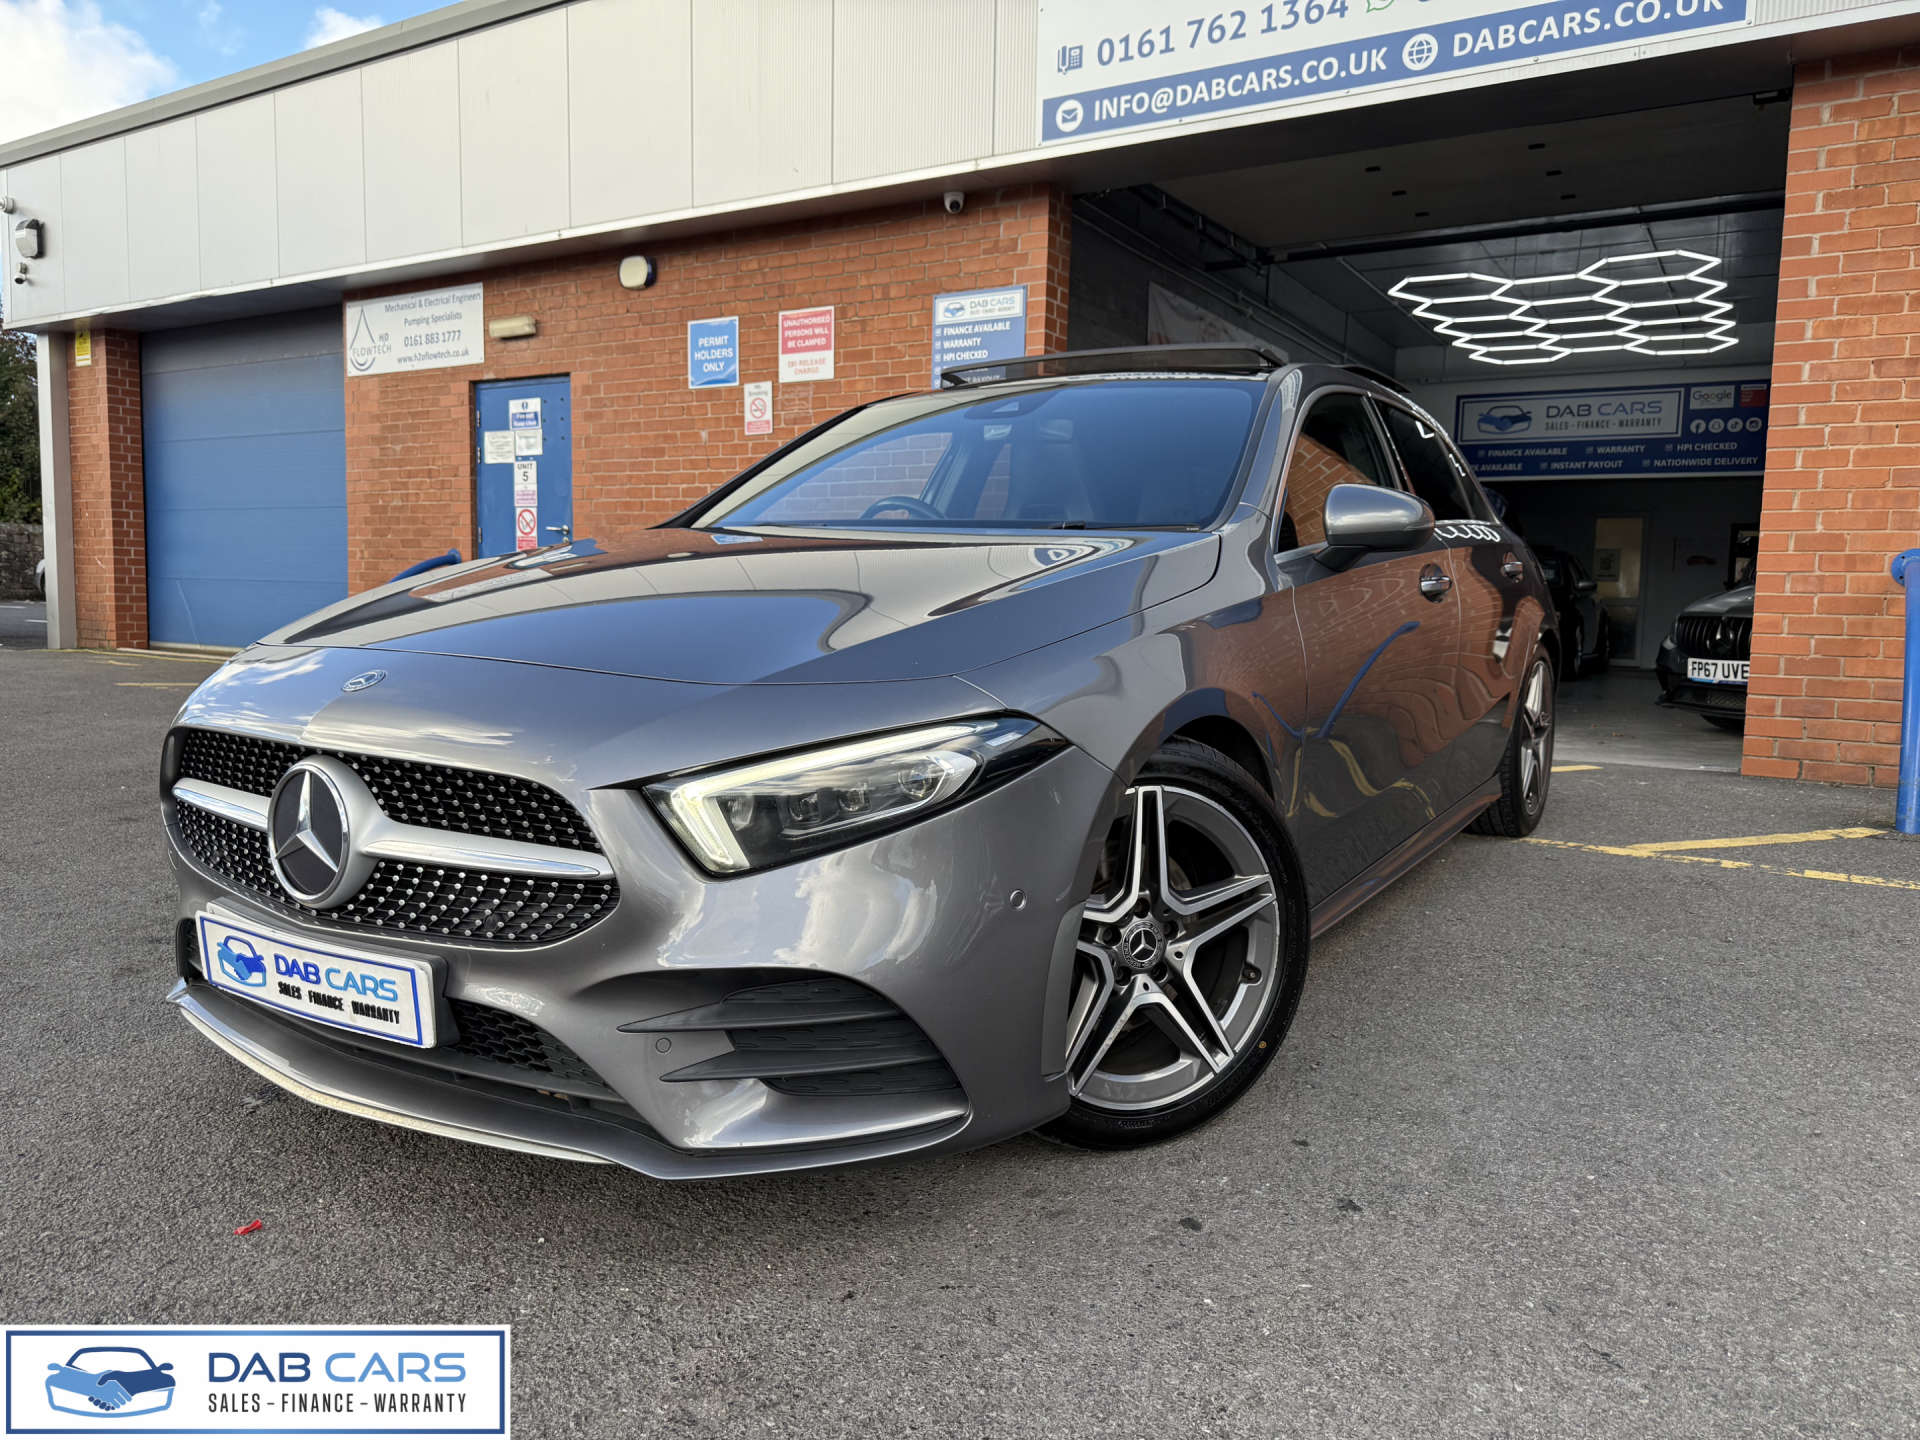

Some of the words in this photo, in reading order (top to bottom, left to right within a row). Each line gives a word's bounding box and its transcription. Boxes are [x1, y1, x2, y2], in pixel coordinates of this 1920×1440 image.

[1097, 25, 1175, 66] 0161
[1187, 11, 1247, 49] 762
[1261, 0, 1349, 34] 1364
[1453, 0, 1724, 57] DABCARS.CO.UK
[1093, 47, 1388, 121] INFO@DABCARS.CO.UK
[384, 300, 417, 313] Mechanical
[424, 294, 452, 308] Electrical
[452, 292, 481, 306] Engineers
[404, 316, 430, 328] Pumping
[431, 311, 463, 323] Specialists
[814, 326, 829, 336] WILL
[943, 324, 973, 336] FINANCE
[974, 320, 1011, 333] AVAILABLE
[404, 335, 423, 347] 0161
[442, 329, 461, 343] 1777
[698, 335, 729, 348] PERMIT
[797, 338, 827, 348] CLAMPED
[943, 337, 982, 349] WARRANTY
[352, 343, 392, 358] FLOWTECH
[694, 348, 734, 361] HOLDERS
[956, 350, 989, 361] CHECKED
[703, 361, 725, 373] ONLY
[1692, 389, 1733, 402] Google
[1546, 403, 1592, 419] DAB
[1597, 400, 1663, 416] CARS
[1545, 420, 1569, 431] SALES
[1577, 418, 1610, 430] FINANCE
[1618, 417, 1662, 429] WARRANTY
[1487, 448, 1522, 458] FINANCE
[1523, 446, 1568, 457] AVAILABLE
[1597, 444, 1646, 455] WARRANTY
[1677, 443, 1691, 452] HPI
[1692, 441, 1738, 452] CHECKED
[517, 463, 533, 471] UNIT
[1480, 462, 1523, 472] AVAILABLE
[1551, 461, 1586, 470] INSTANT
[1587, 460, 1624, 470] PAYOUT
[1653, 457, 1714, 468] NATIONWIDE
[1714, 455, 1759, 466] DELIVERY
[522, 471, 529, 482] 5
[1691, 661, 1718, 678] FP67
[1722, 663, 1750, 679] UVE
[273, 953, 321, 985] DAB
[325, 967, 398, 1001] CARS
[277, 981, 302, 1001] SALES
[308, 990, 344, 1011] FINANCE
[351, 1000, 400, 1024] WARRANTY
